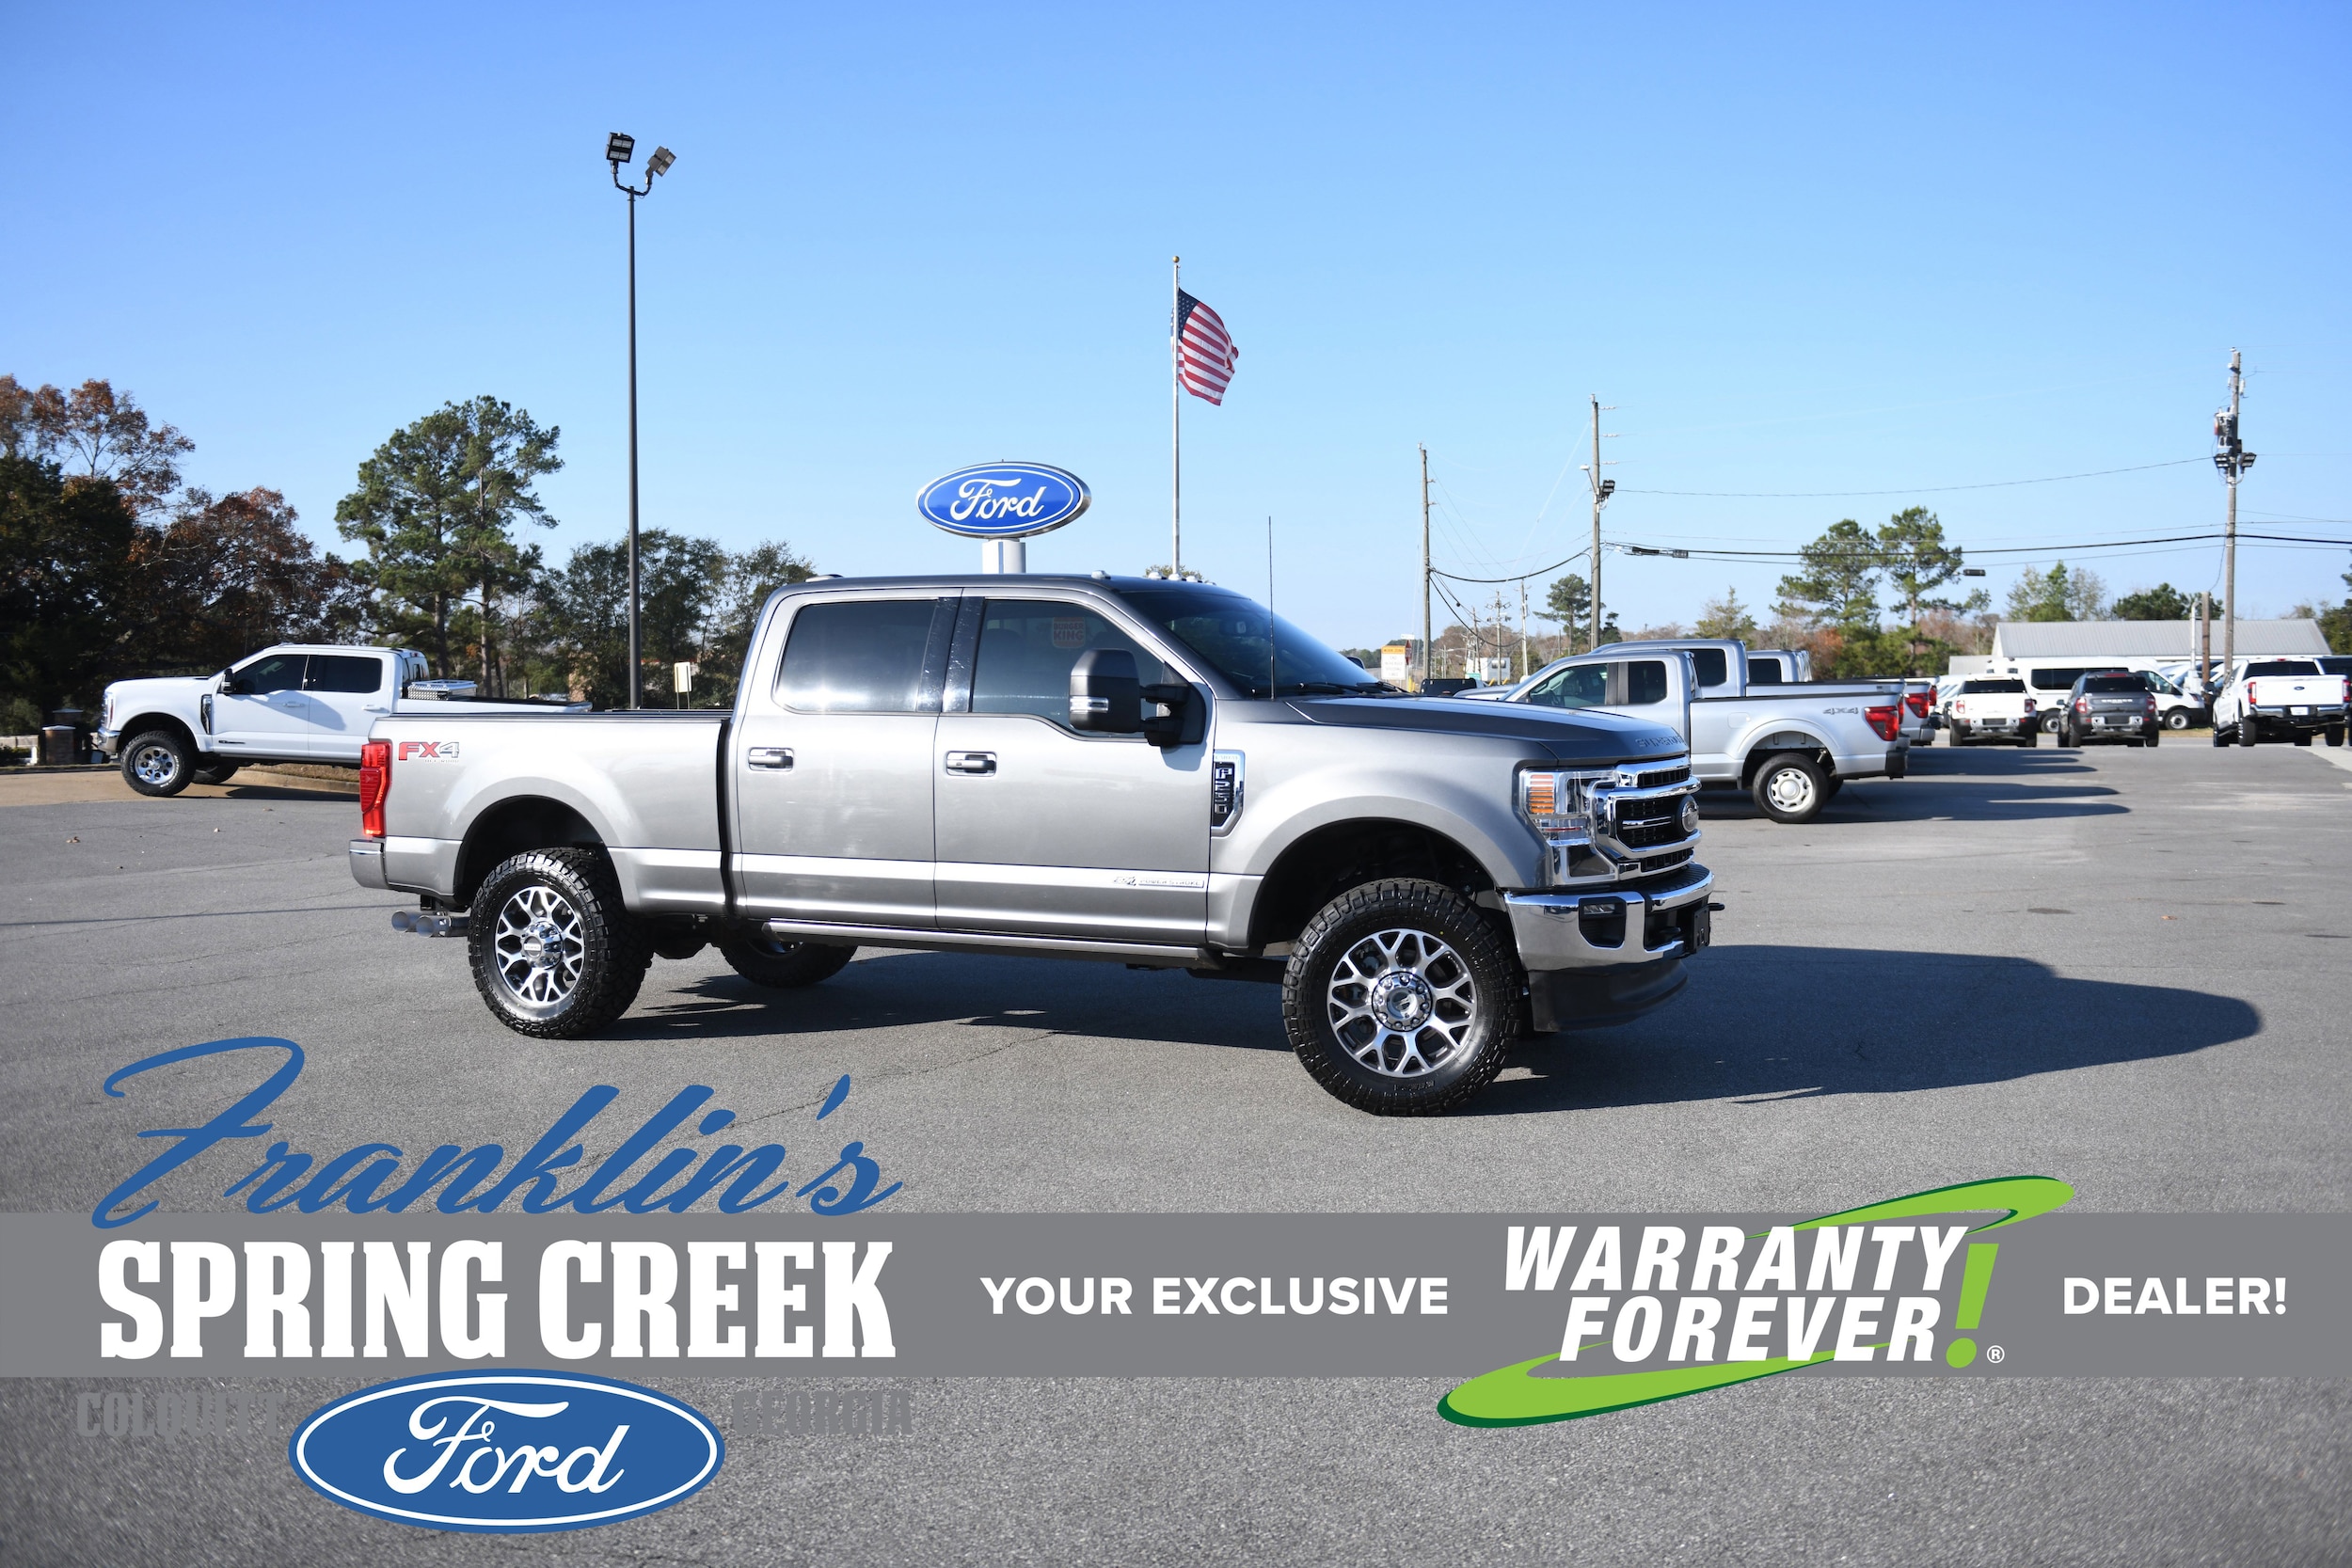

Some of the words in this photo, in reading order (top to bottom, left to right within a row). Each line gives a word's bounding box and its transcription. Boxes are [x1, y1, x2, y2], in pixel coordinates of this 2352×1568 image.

[950, 478, 1047, 521] Ford
[1053, 630, 1084, 641] KING
[398, 741, 460, 761] FX4
